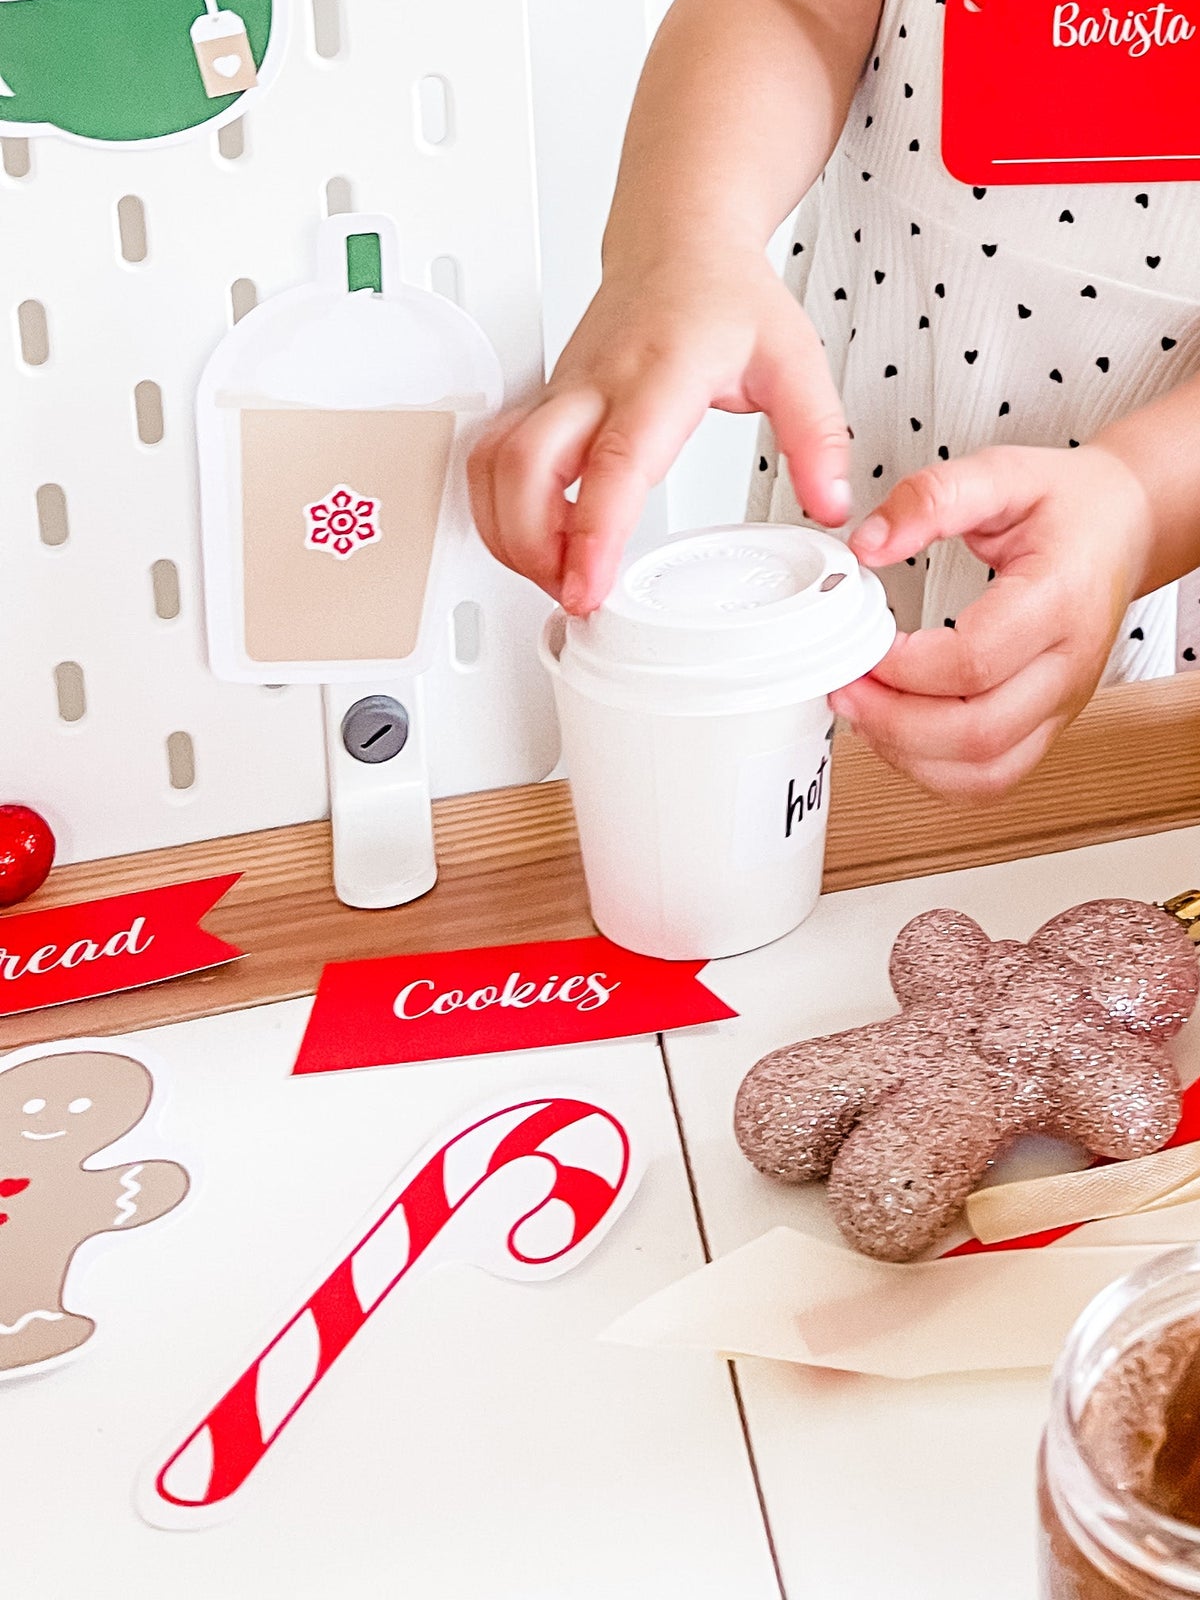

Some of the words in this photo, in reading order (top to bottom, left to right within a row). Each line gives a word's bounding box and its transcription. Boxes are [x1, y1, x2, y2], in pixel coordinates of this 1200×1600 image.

[1052, 2, 1196, 58] Barista
[785, 756, 828, 838] hot
[393, 972, 621, 1020] Cookies
